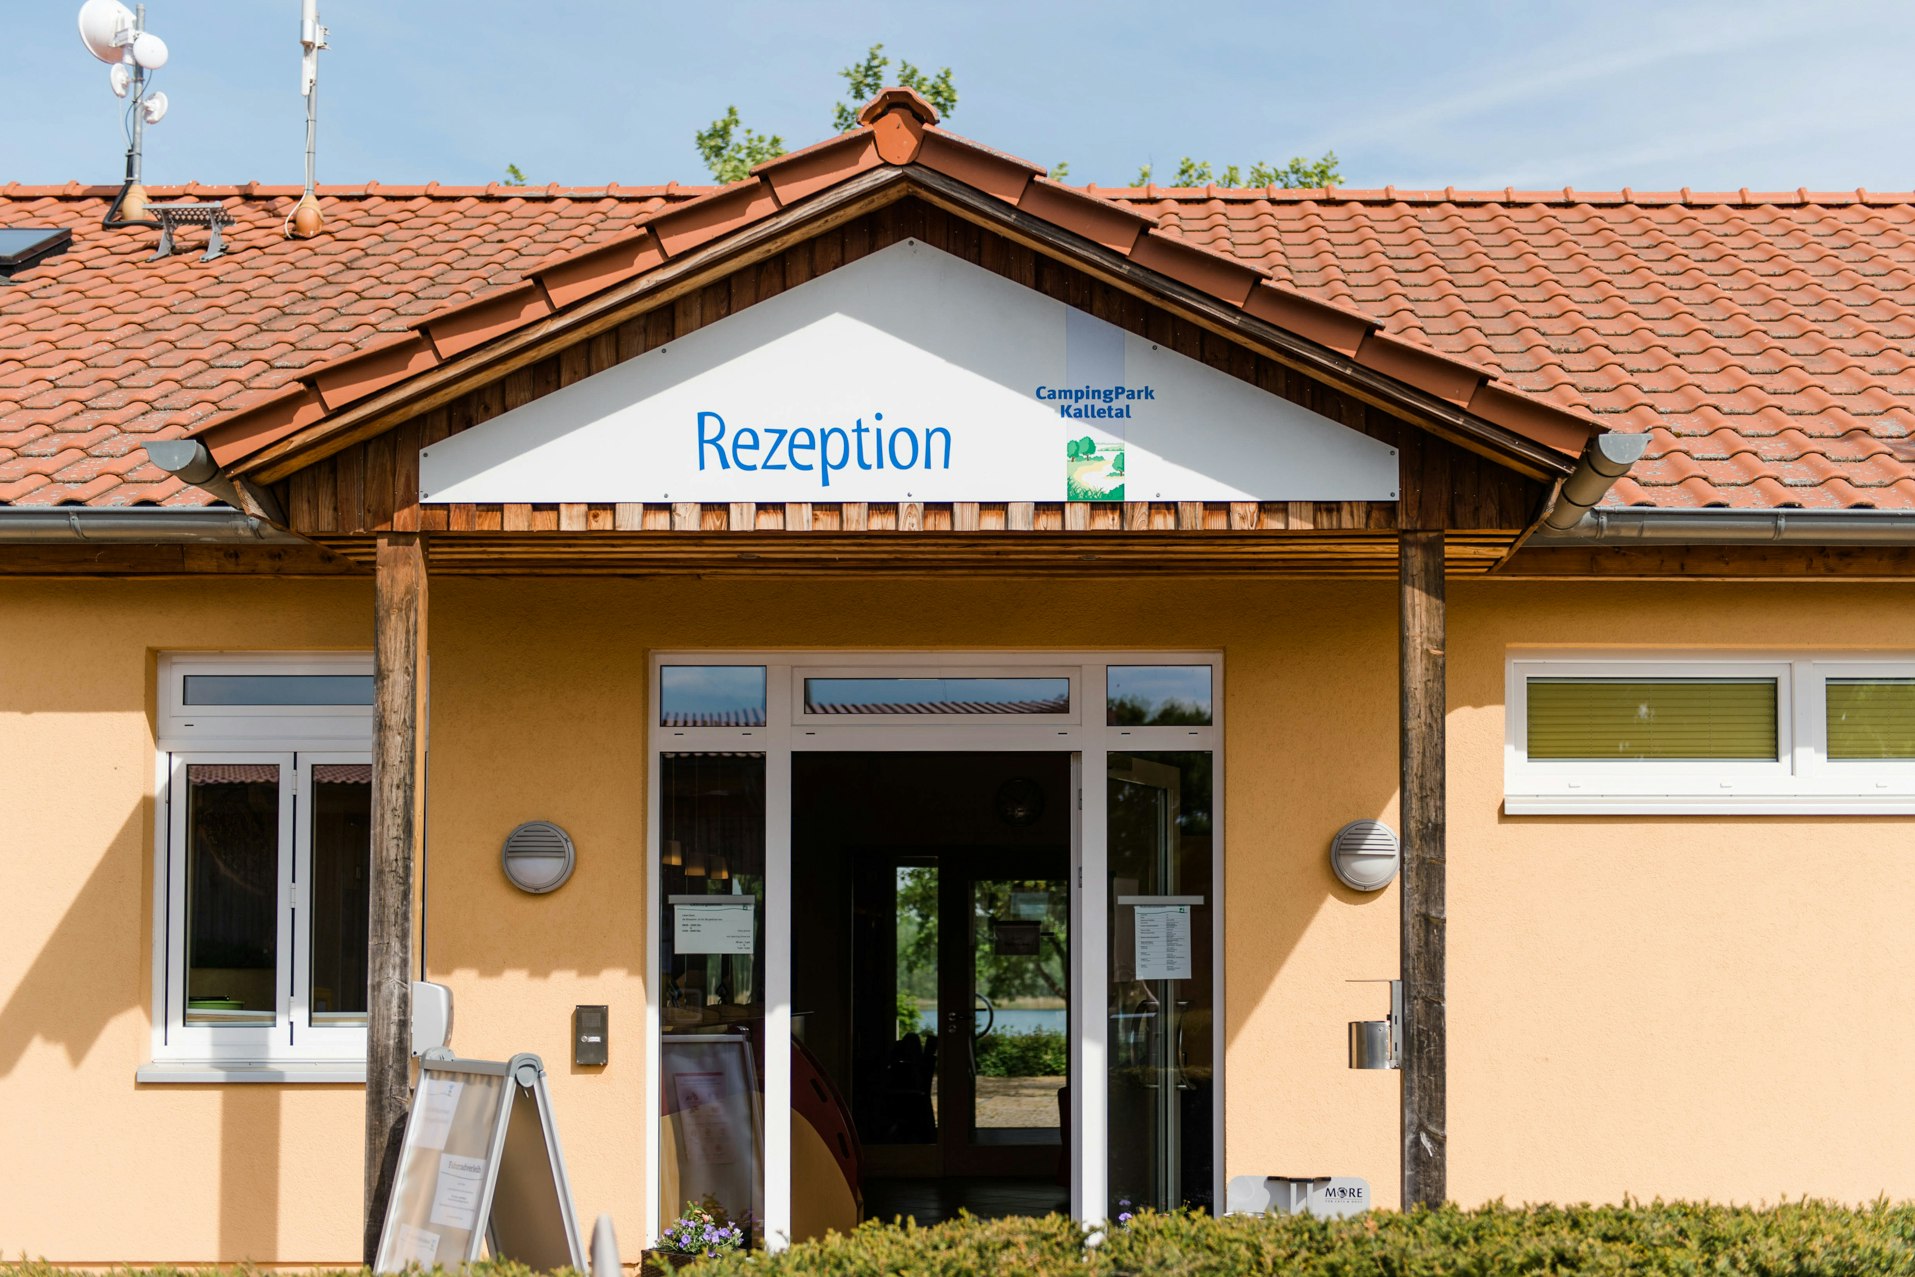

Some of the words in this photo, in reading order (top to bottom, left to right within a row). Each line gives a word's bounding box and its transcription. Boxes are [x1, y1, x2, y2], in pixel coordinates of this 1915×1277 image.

[1036, 385, 1155, 403] CampingPark
[1060, 404, 1132, 418] Kalletal
[697, 411, 951, 487] Rezeption
